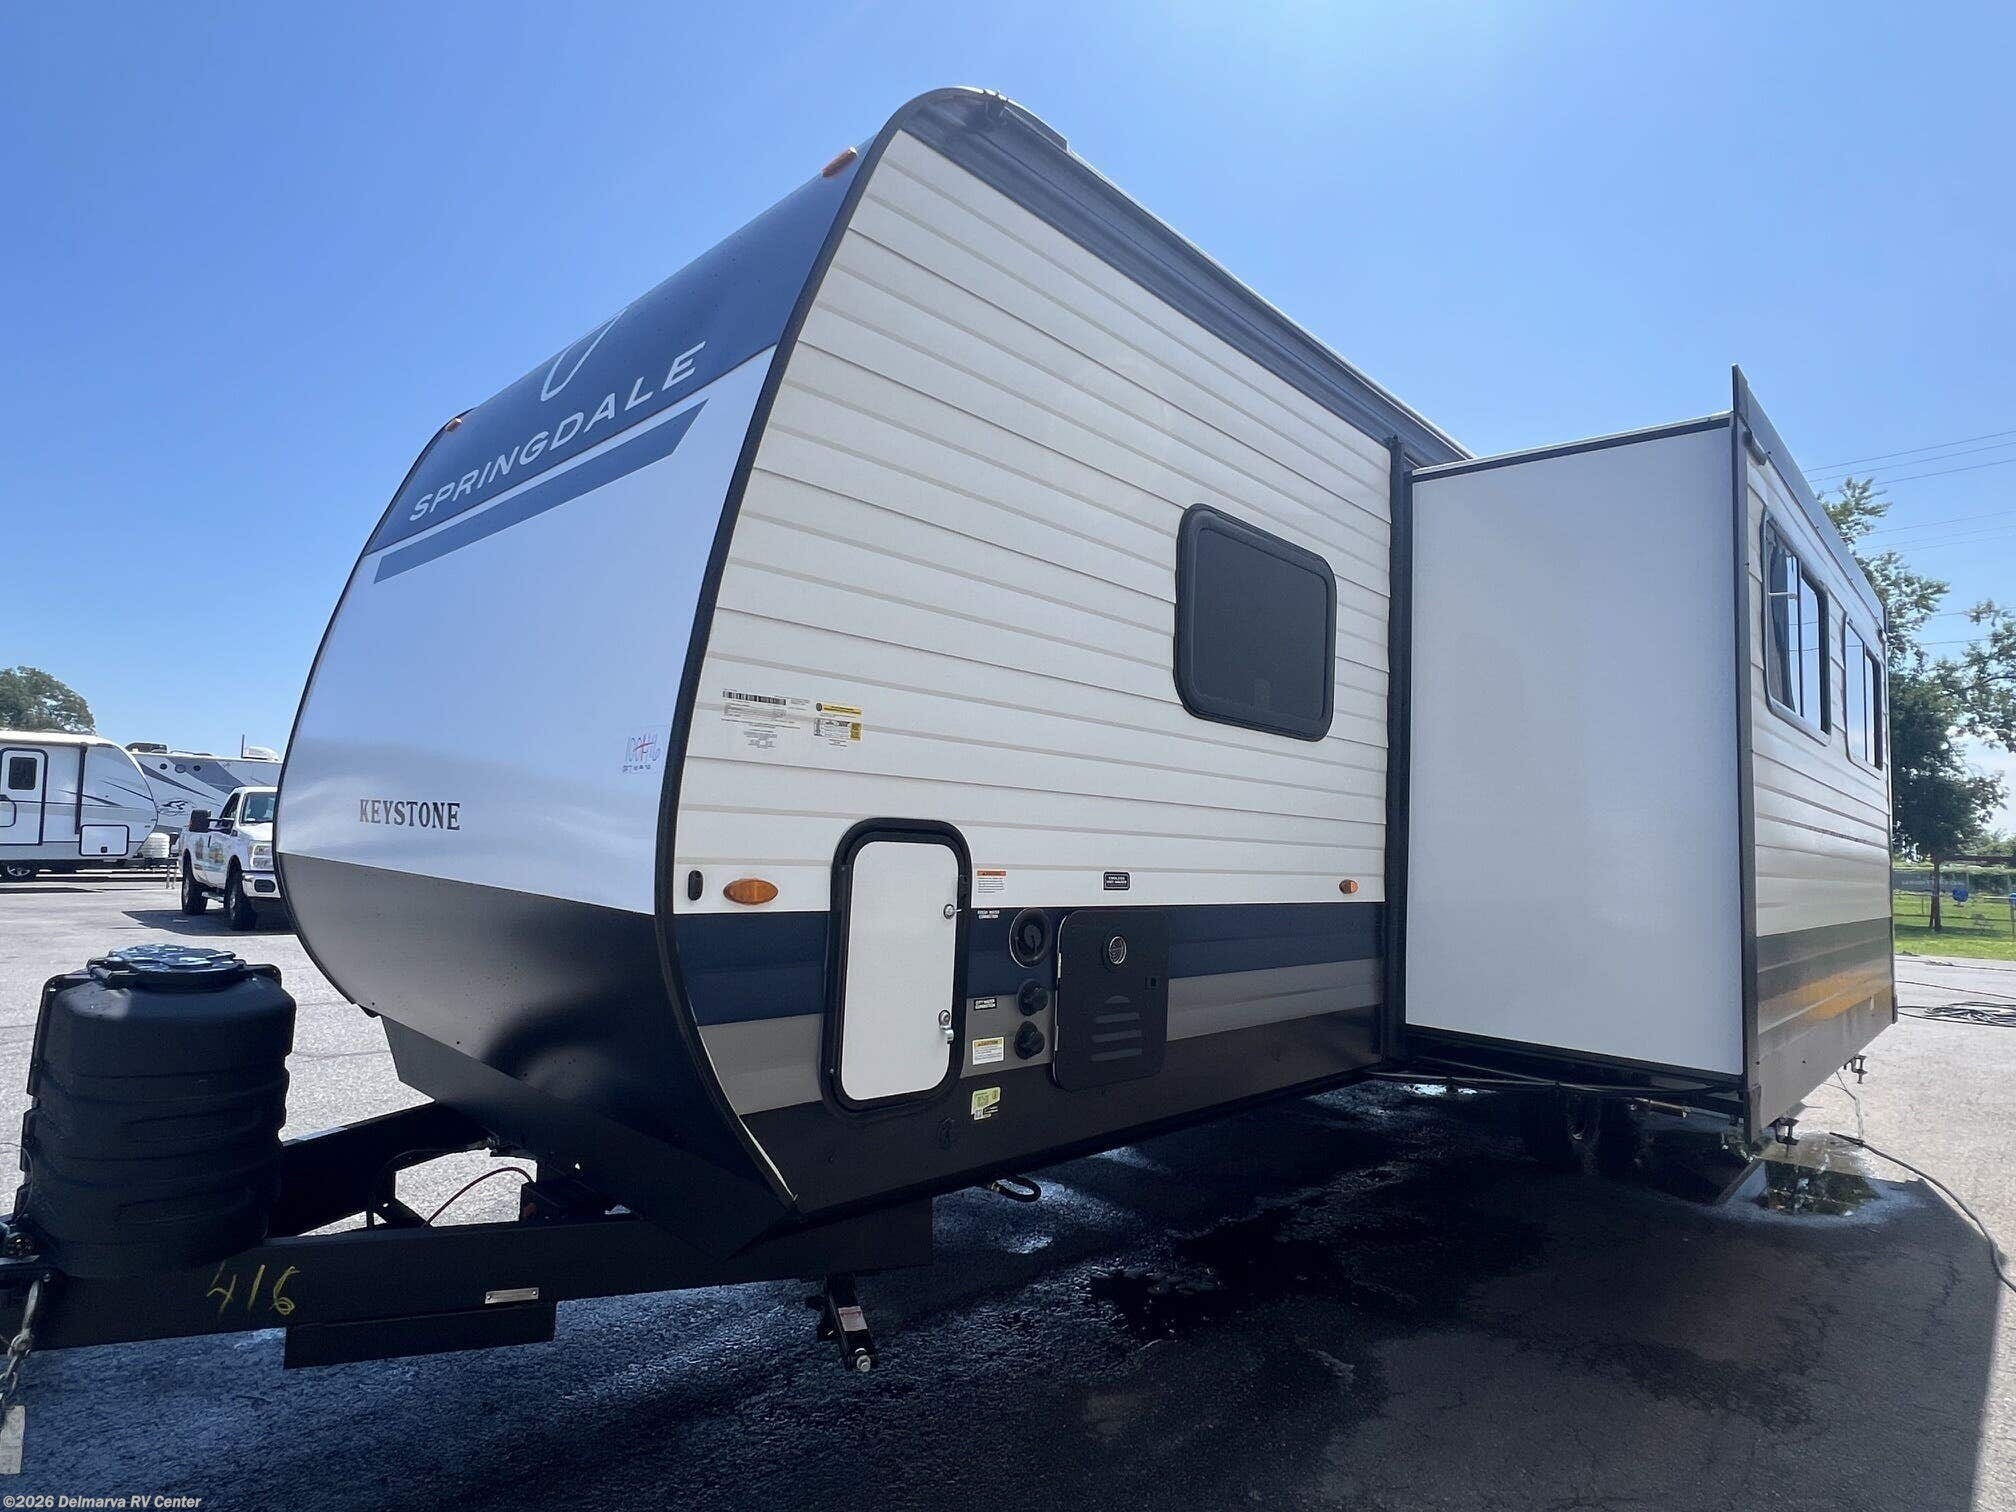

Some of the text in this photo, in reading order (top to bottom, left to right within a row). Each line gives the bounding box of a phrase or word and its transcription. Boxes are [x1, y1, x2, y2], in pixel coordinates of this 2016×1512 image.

[409, 340, 707, 522] SPRINGDALE
[359, 799, 461, 831] KEYSTONE
[206, 1260, 300, 1317] 416
